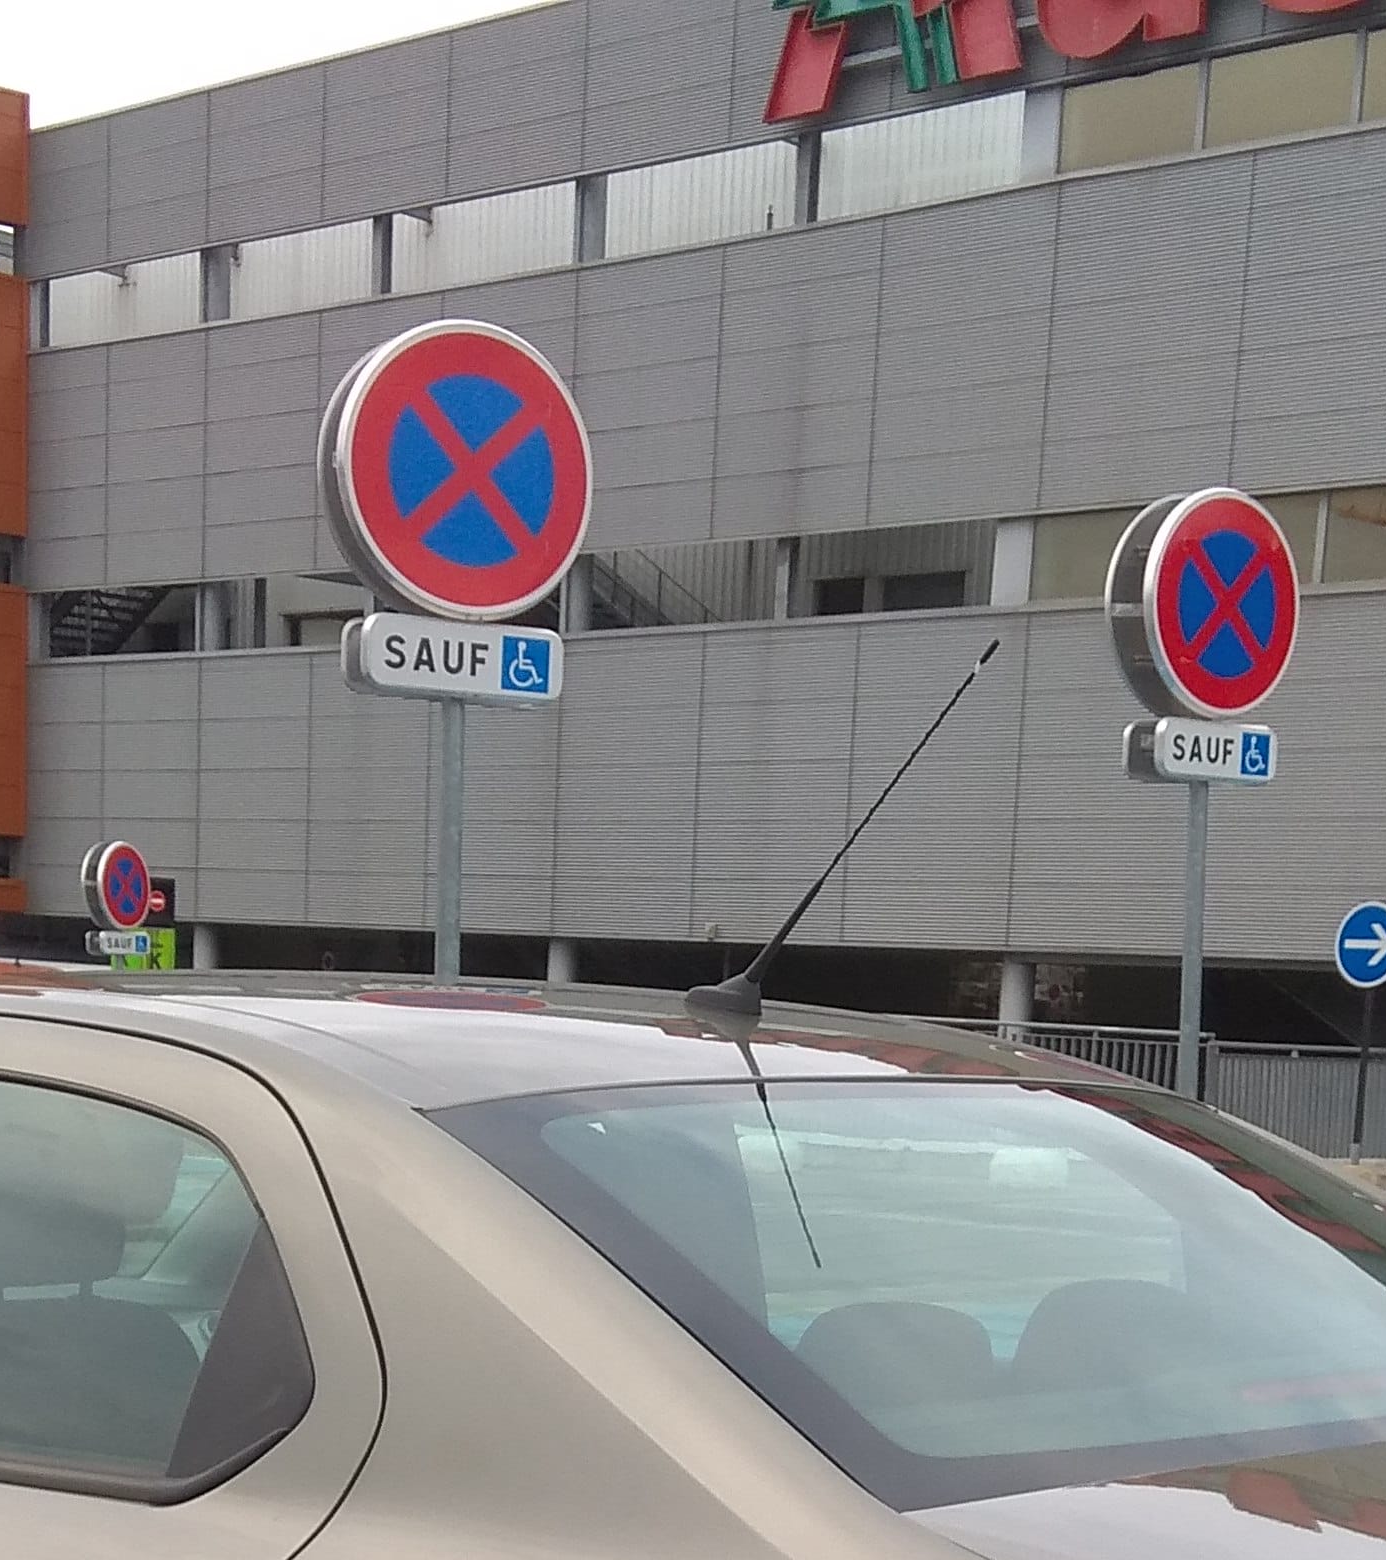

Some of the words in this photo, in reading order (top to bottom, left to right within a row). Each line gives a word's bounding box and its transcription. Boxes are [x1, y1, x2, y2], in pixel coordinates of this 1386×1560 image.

[384, 634, 489, 677] SAUF
[1172, 734, 1234, 765] SAUF
[107, 937, 133, 949] SAUF
